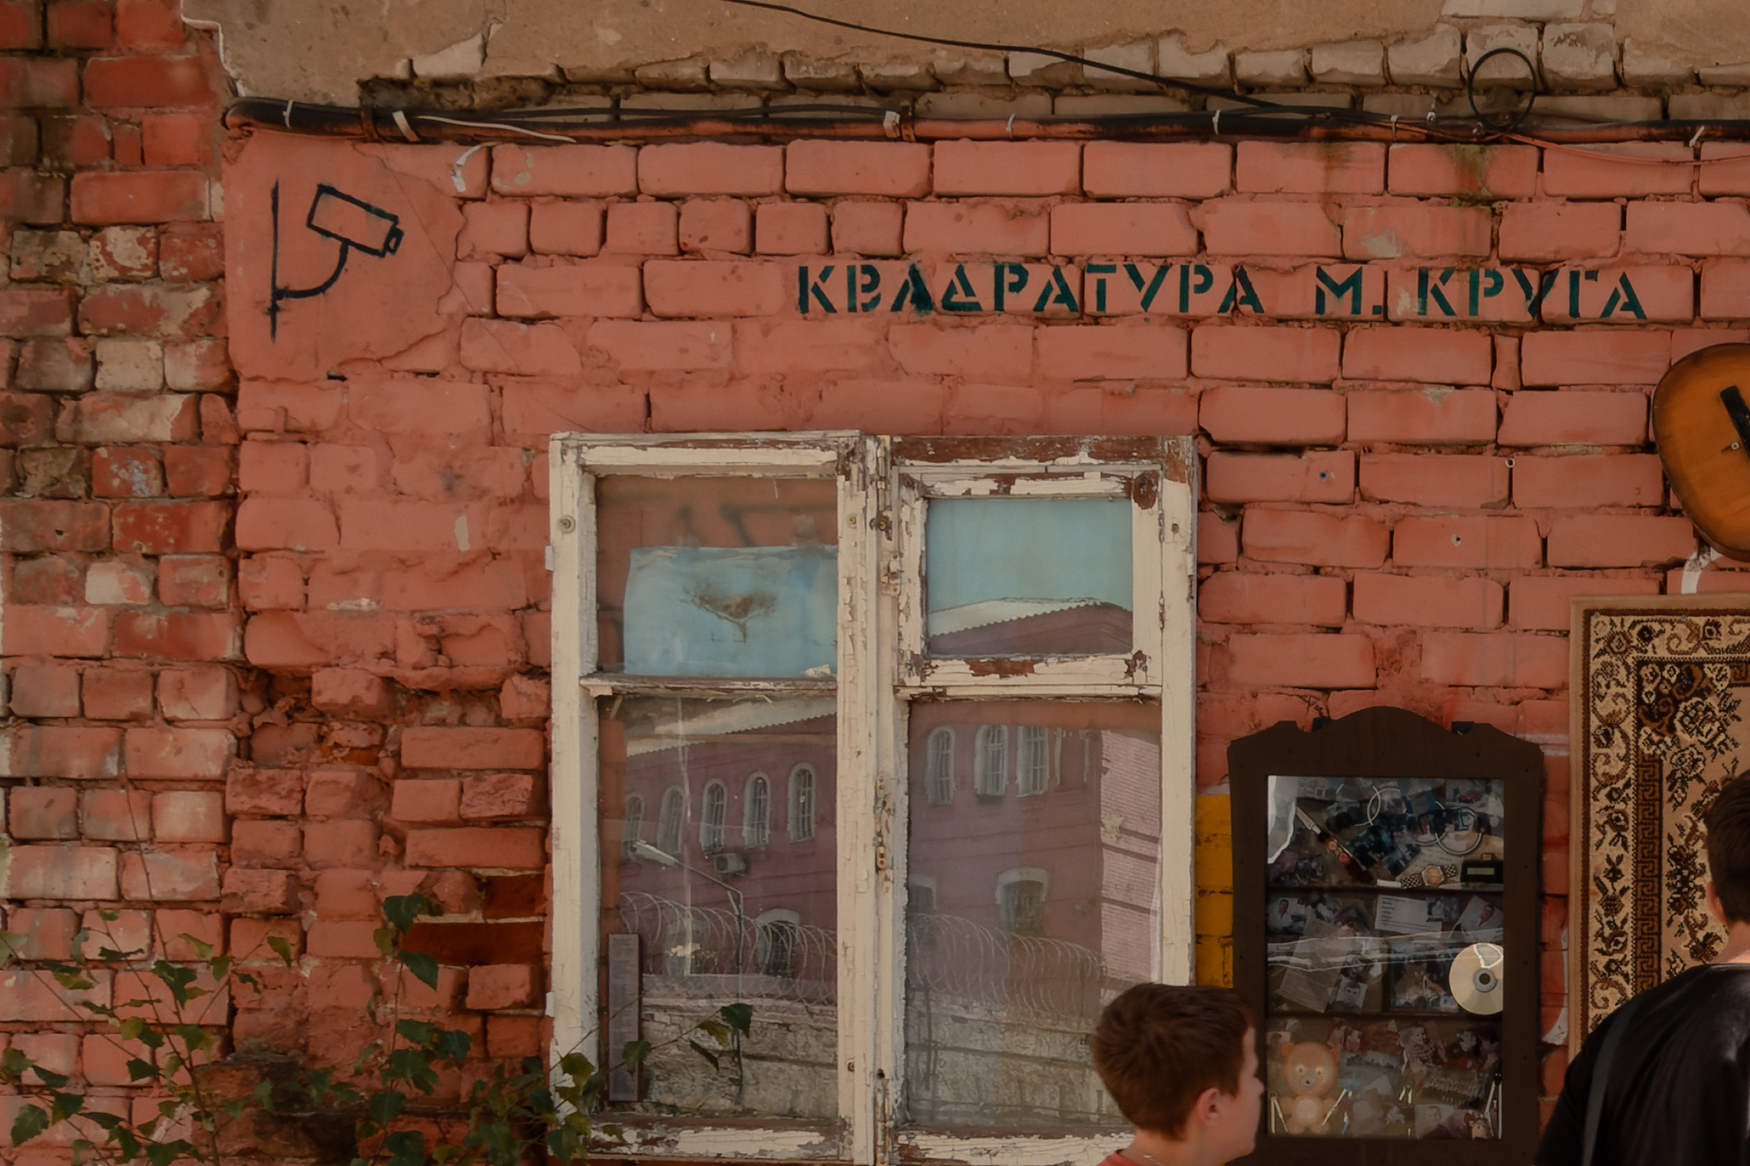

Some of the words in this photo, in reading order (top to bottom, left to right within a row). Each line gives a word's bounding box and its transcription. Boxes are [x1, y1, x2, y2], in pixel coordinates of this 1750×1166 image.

[798, 263, 1265, 316] КВАДРАТУРА
[1315, 265, 1383, 315] М.
[1417, 266, 1648, 320] КРУГА
